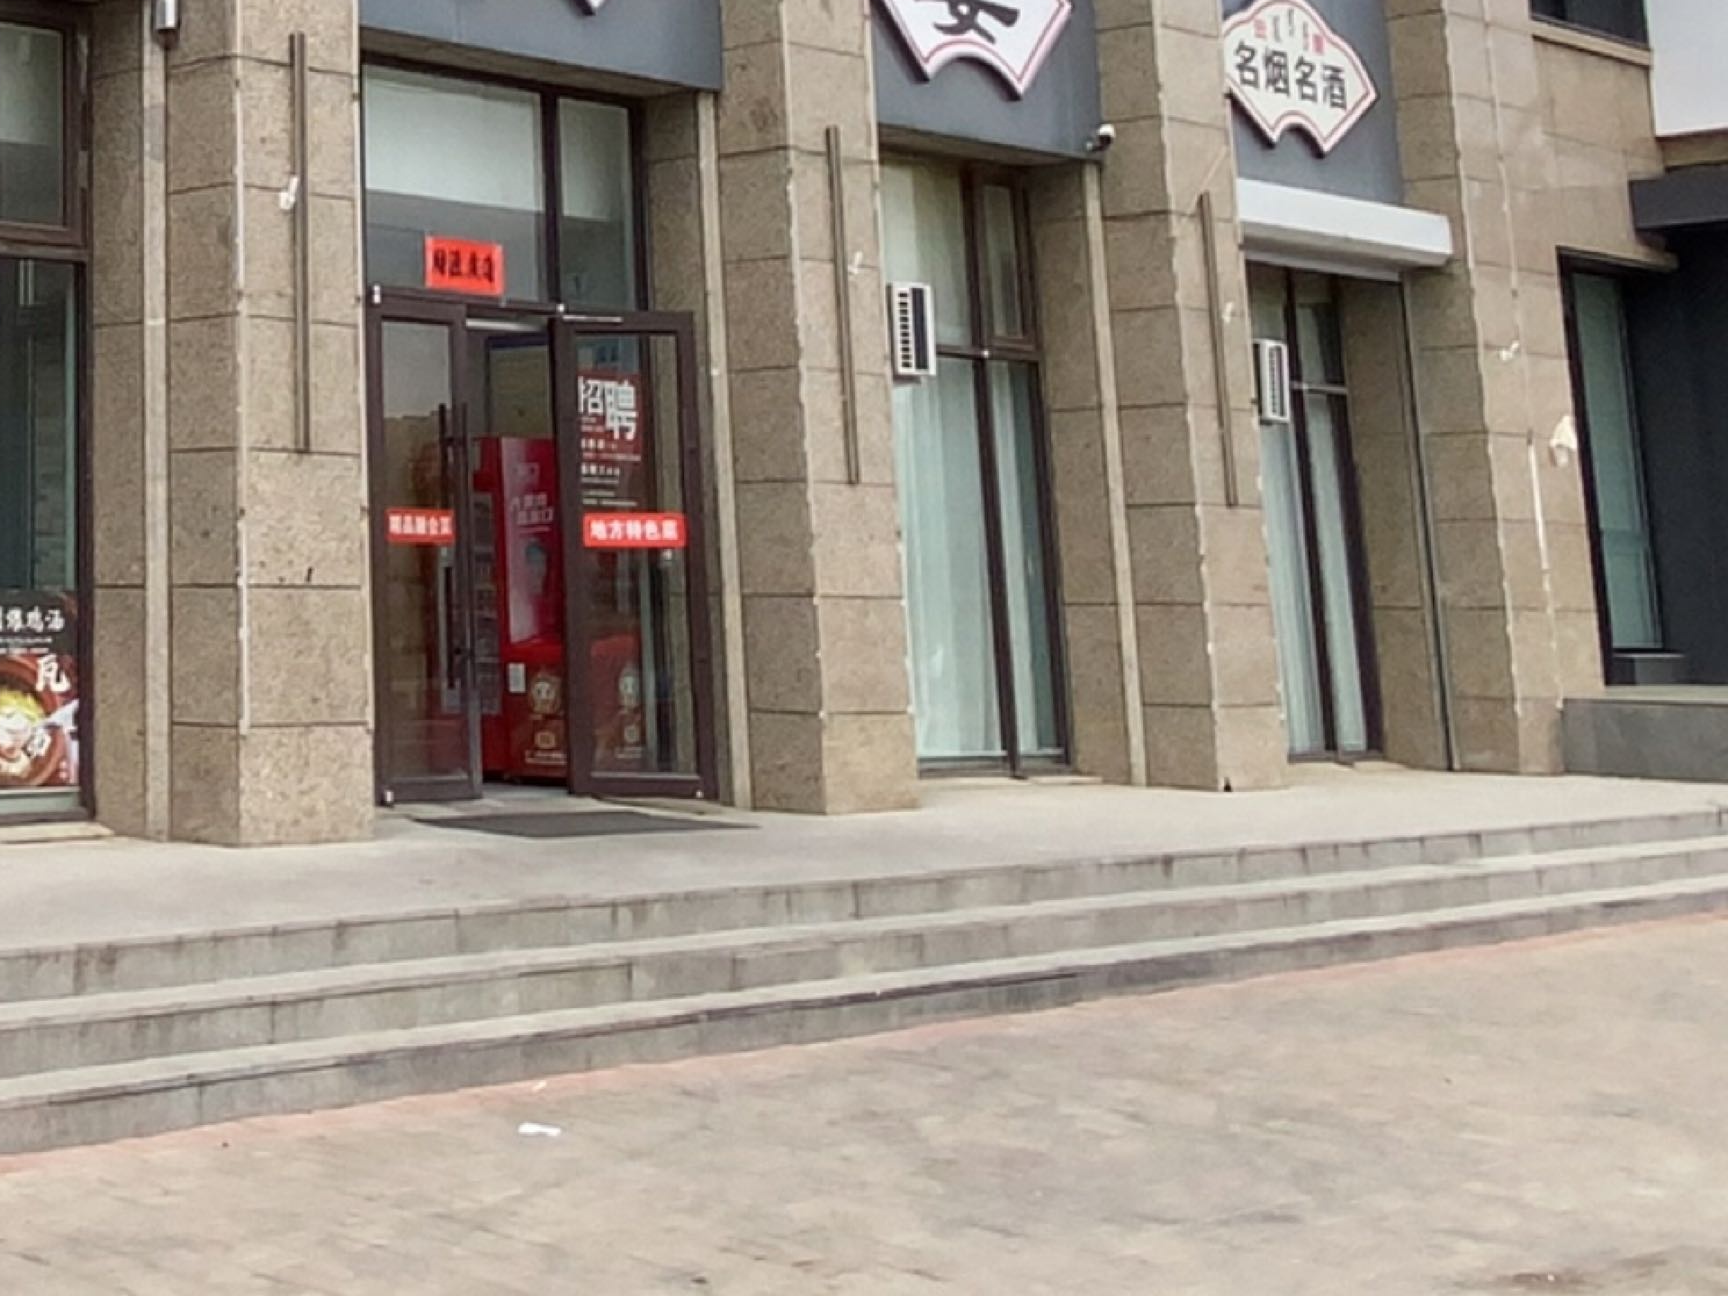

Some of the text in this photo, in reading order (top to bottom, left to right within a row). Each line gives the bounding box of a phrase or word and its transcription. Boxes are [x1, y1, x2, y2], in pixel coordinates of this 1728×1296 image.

[1234, 41, 1348, 111] 名烟名酒
[577, 376, 639, 441] 招聘
[589, 518, 679, 542] 地方特色菜
